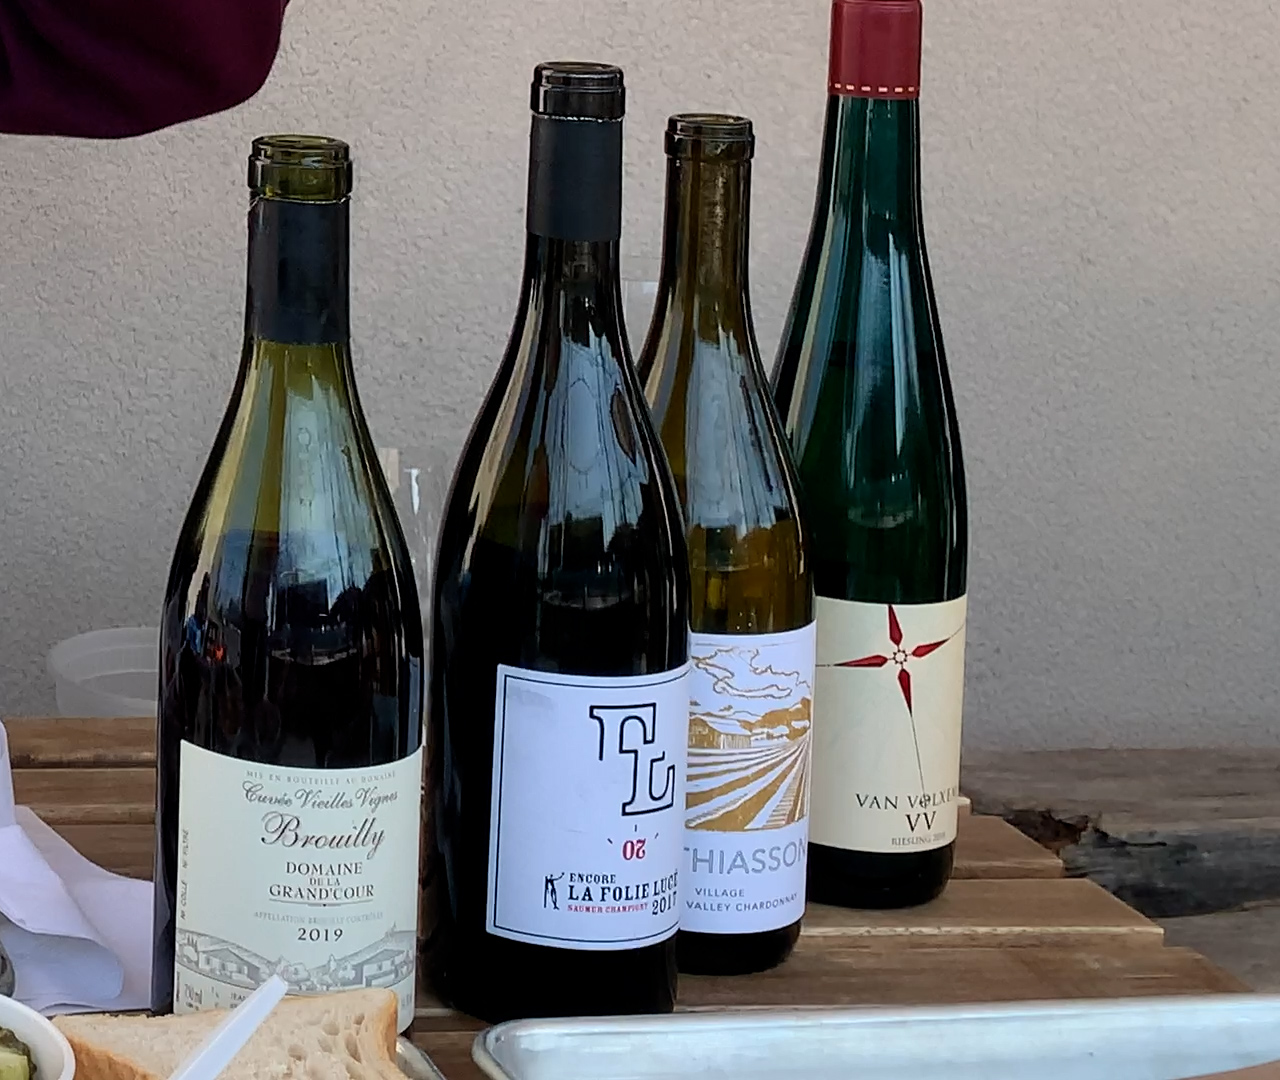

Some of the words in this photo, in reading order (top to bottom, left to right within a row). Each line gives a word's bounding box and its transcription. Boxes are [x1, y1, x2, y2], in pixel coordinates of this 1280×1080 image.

[242, 780, 293, 808] Cuvée
[294, 788, 354, 810] Vieilles
[354, 786, 398, 814] Vignes
[855, 793, 899, 810] VAN
[905, 810, 937, 834] VV
[261, 811, 385, 860] Brouilly
[683, 837, 806, 875] HIASSON
[286, 861, 363, 876] DOMAINE
[309, 878, 324, 887] DE
[326, 878, 341, 887] LA
[569, 872, 617, 884] ENCORE
[269, 884, 375, 900] GRAND'COUR
[567, 884, 594, 902] LA
[599, 883, 650, 903] FOLIE
[695, 887, 745, 898] VILLAGE
[651, 890, 678, 916] 2017
[686, 900, 731, 912] VALLEY
[735, 892, 798, 912] CHARDONNAY
[297, 927, 344, 942] 2019
